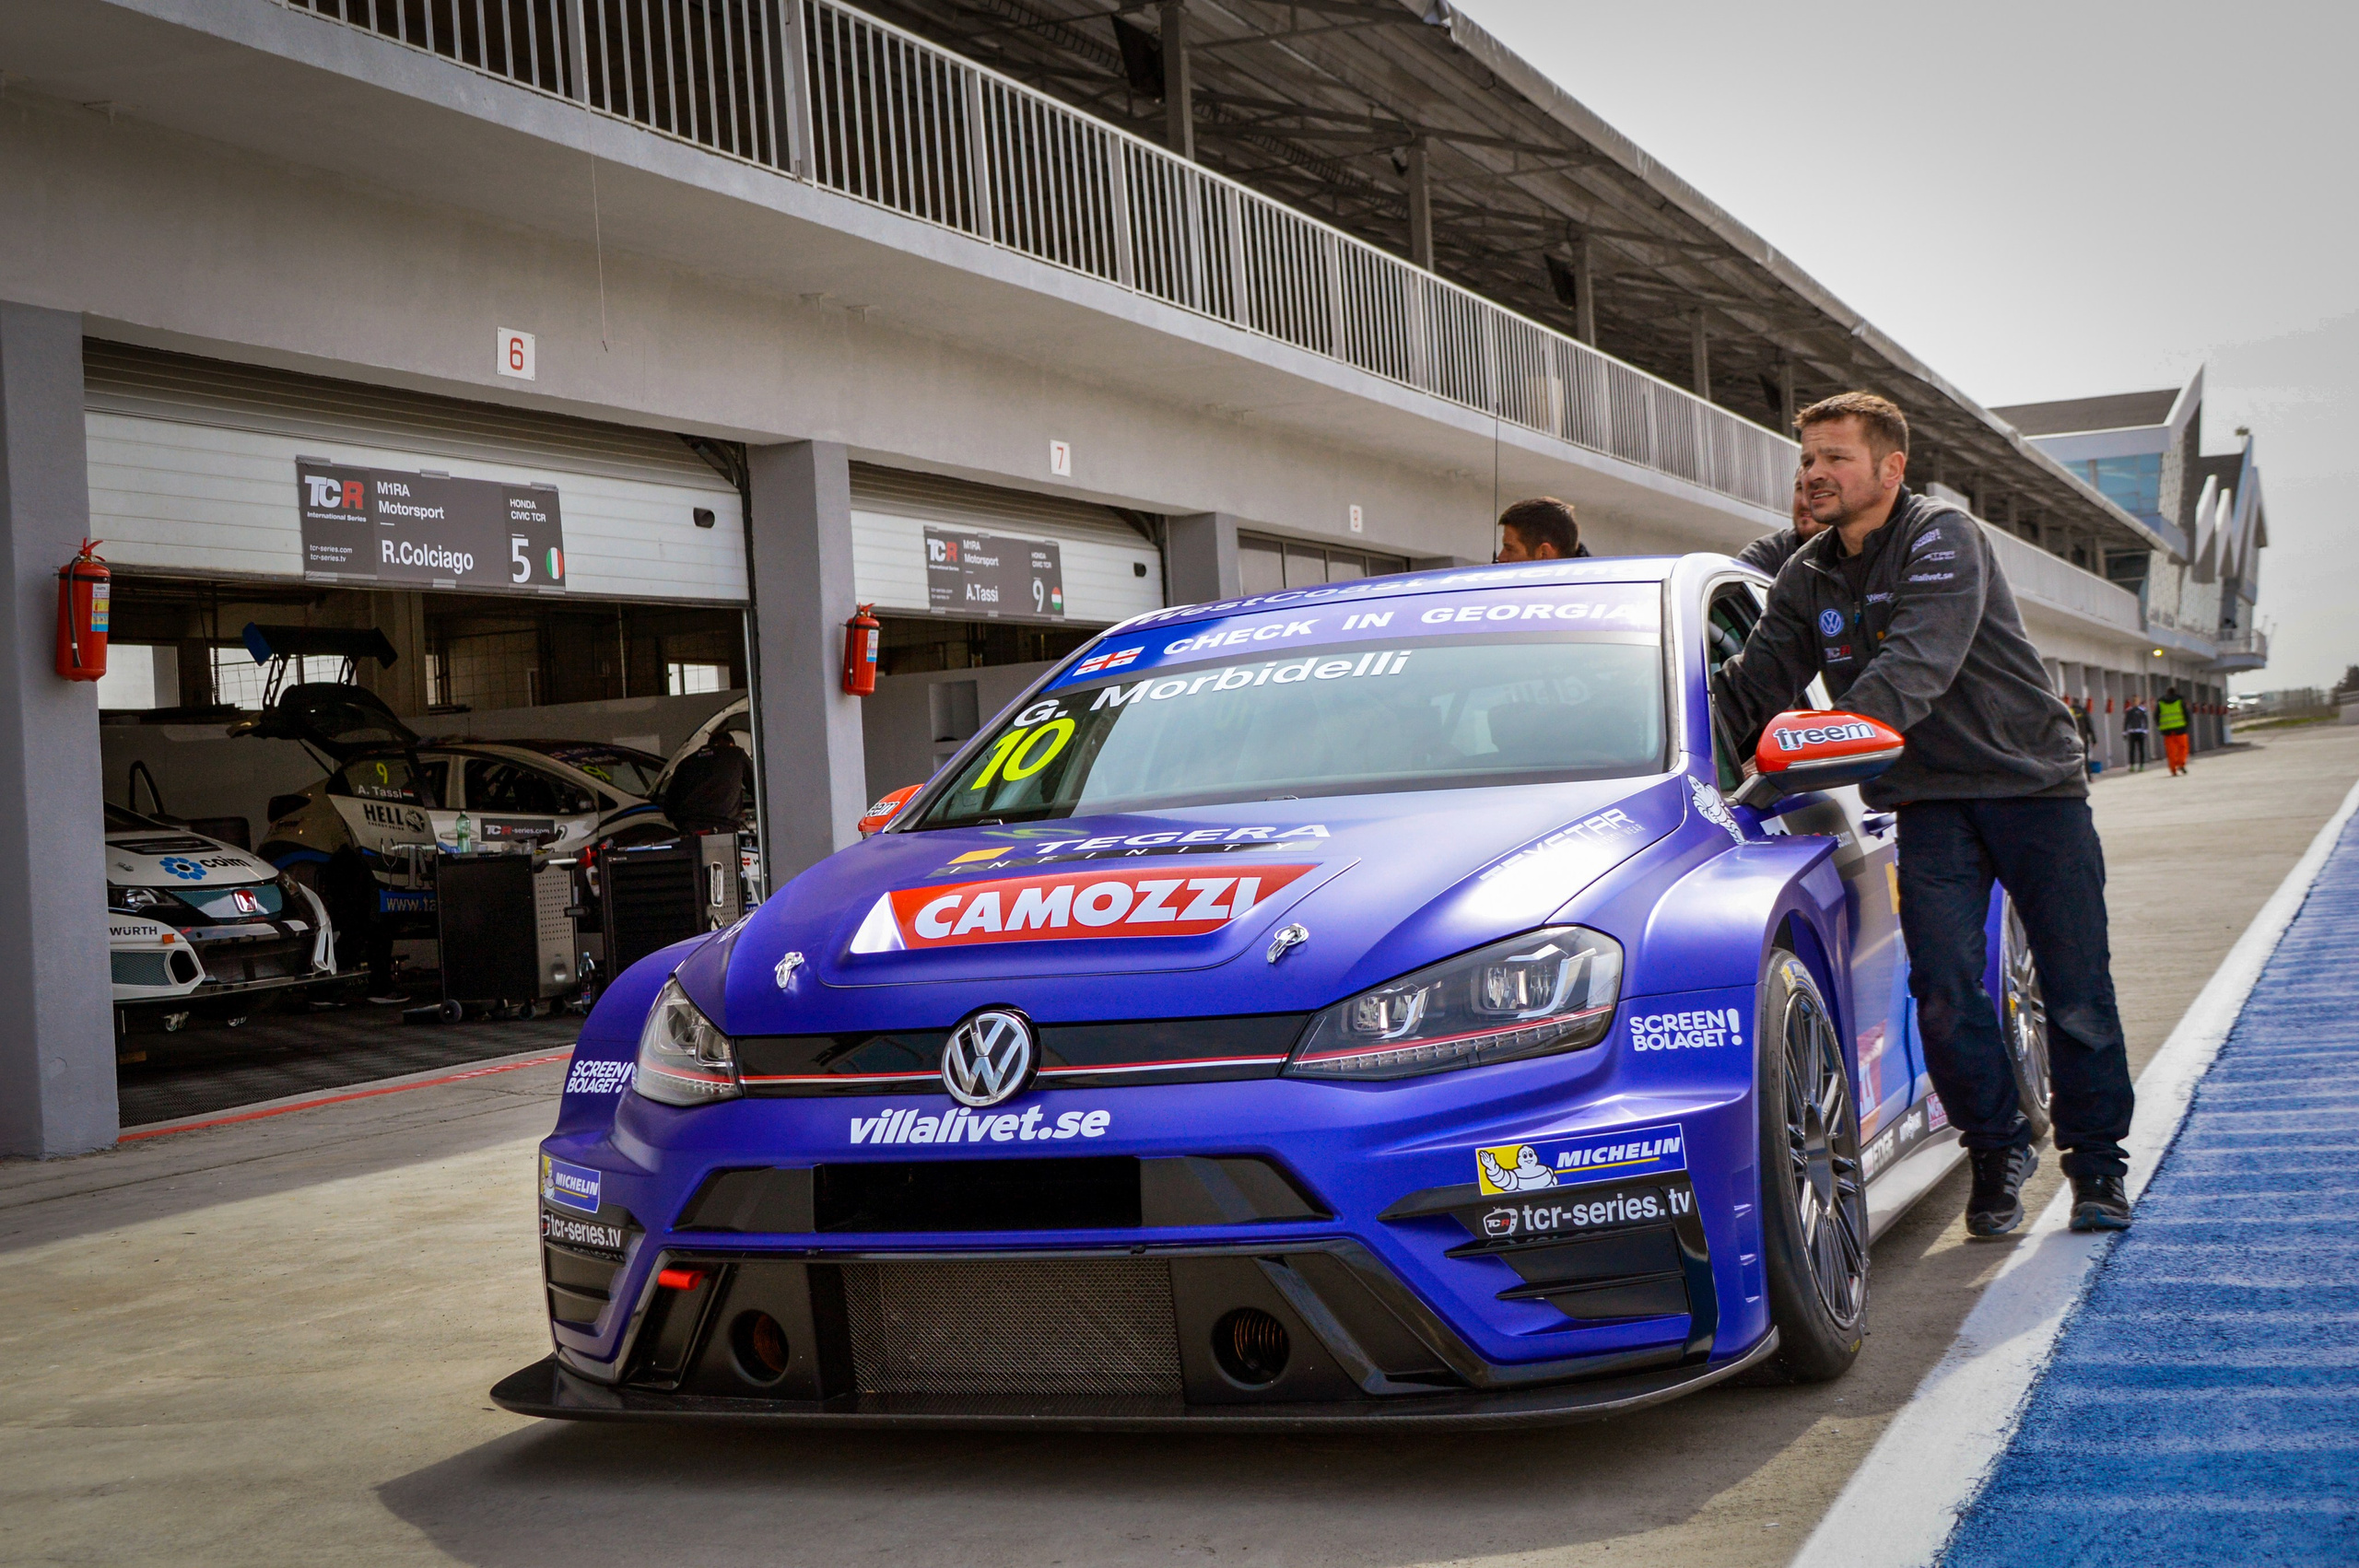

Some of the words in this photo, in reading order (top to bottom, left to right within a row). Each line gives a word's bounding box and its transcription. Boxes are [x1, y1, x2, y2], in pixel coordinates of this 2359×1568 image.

[510, 337, 524, 371] 6
[1057, 447, 1063, 469] 7
[305, 475, 364, 509] TCR
[377, 481, 410, 497] M1RA
[307, 511, 346, 521] International
[378, 500, 444, 520] Motorsport
[510, 498, 536, 509] HONDA
[511, 510, 531, 521] CIVIC
[531, 512, 546, 522] TCR
[310, 544, 353, 554] tcr-series.com
[310, 554, 346, 563] tcr-series.tv
[381, 540, 474, 575] R.Colciago
[511, 537, 532, 583] 5
[927, 538, 958, 563] TCR
[965, 554, 999, 568] Motorsport
[966, 583, 999, 603] A.Tassi
[1033, 579, 1044, 613] 9
[1163, 618, 1320, 655] CHECK
[1342, 612, 1395, 630] IN
[1421, 603, 1637, 625] GEORGIA
[1014, 699, 1069, 728] G.
[1090, 650, 1412, 711] Morbidelli
[1774, 722, 1874, 748] freem
[970, 718, 1075, 790] 10
[376, 762, 388, 784] 9
[358, 784, 370, 795] A.
[371, 786, 403, 799] Tassi
[363, 802, 404, 825] HELL
[1036, 825, 1331, 855] TEGERA
[199, 856, 252, 869] coim
[949, 842, 1295, 874] INFINITY
[914, 876, 1262, 940] CAMOZZI
[1629, 1009, 1726, 1035] SCREEN
[571, 1060, 626, 1079] SCREEN
[851, 1105, 1110, 1144] villalivet.se
[1556, 1137, 1681, 1168] MICHELIN
[556, 1172, 599, 1196] MICHELIN
[1486, 1218, 1510, 1228] TCR
[1522, 1188, 1690, 1231] tcr-series.tv
[551, 1214, 621, 1248] tcr-series.tv
